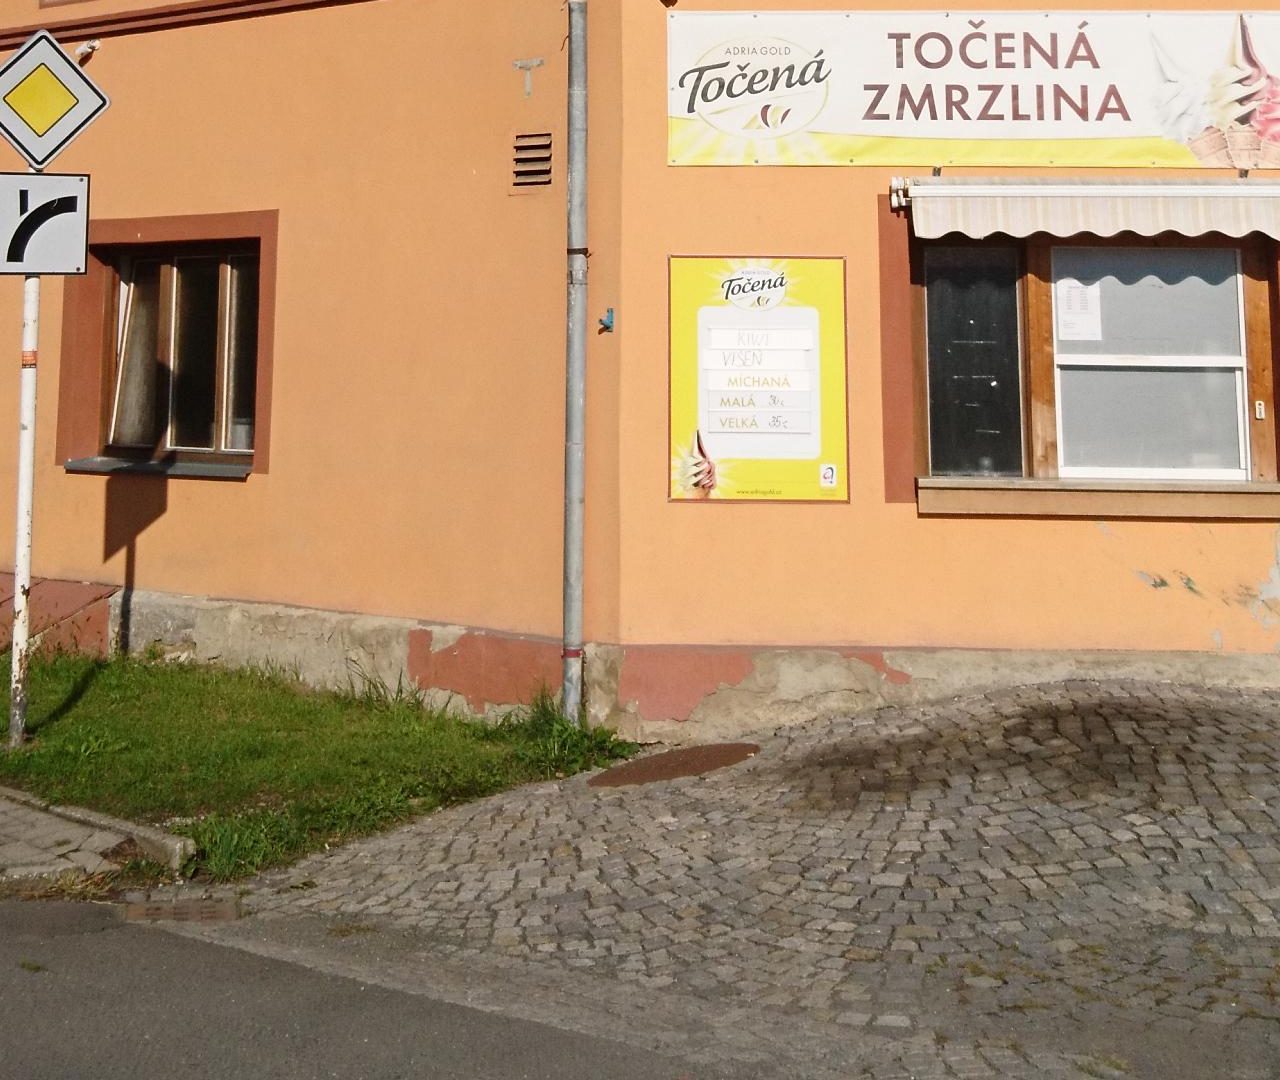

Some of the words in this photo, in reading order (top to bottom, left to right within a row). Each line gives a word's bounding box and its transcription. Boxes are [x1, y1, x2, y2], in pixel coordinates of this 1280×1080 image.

[725, 47, 758, 56] ADRIA
[760, 47, 791, 56] GOLD
[887, 19, 1101, 70] TOČENÁ
[678, 48, 832, 114] Točená
[862, 83, 1133, 123] ZMRZLINA
[721, 271, 788, 300] Točená
[719, 394, 756, 407] MALÁ
[719, 414, 759, 429] VELKÁ
